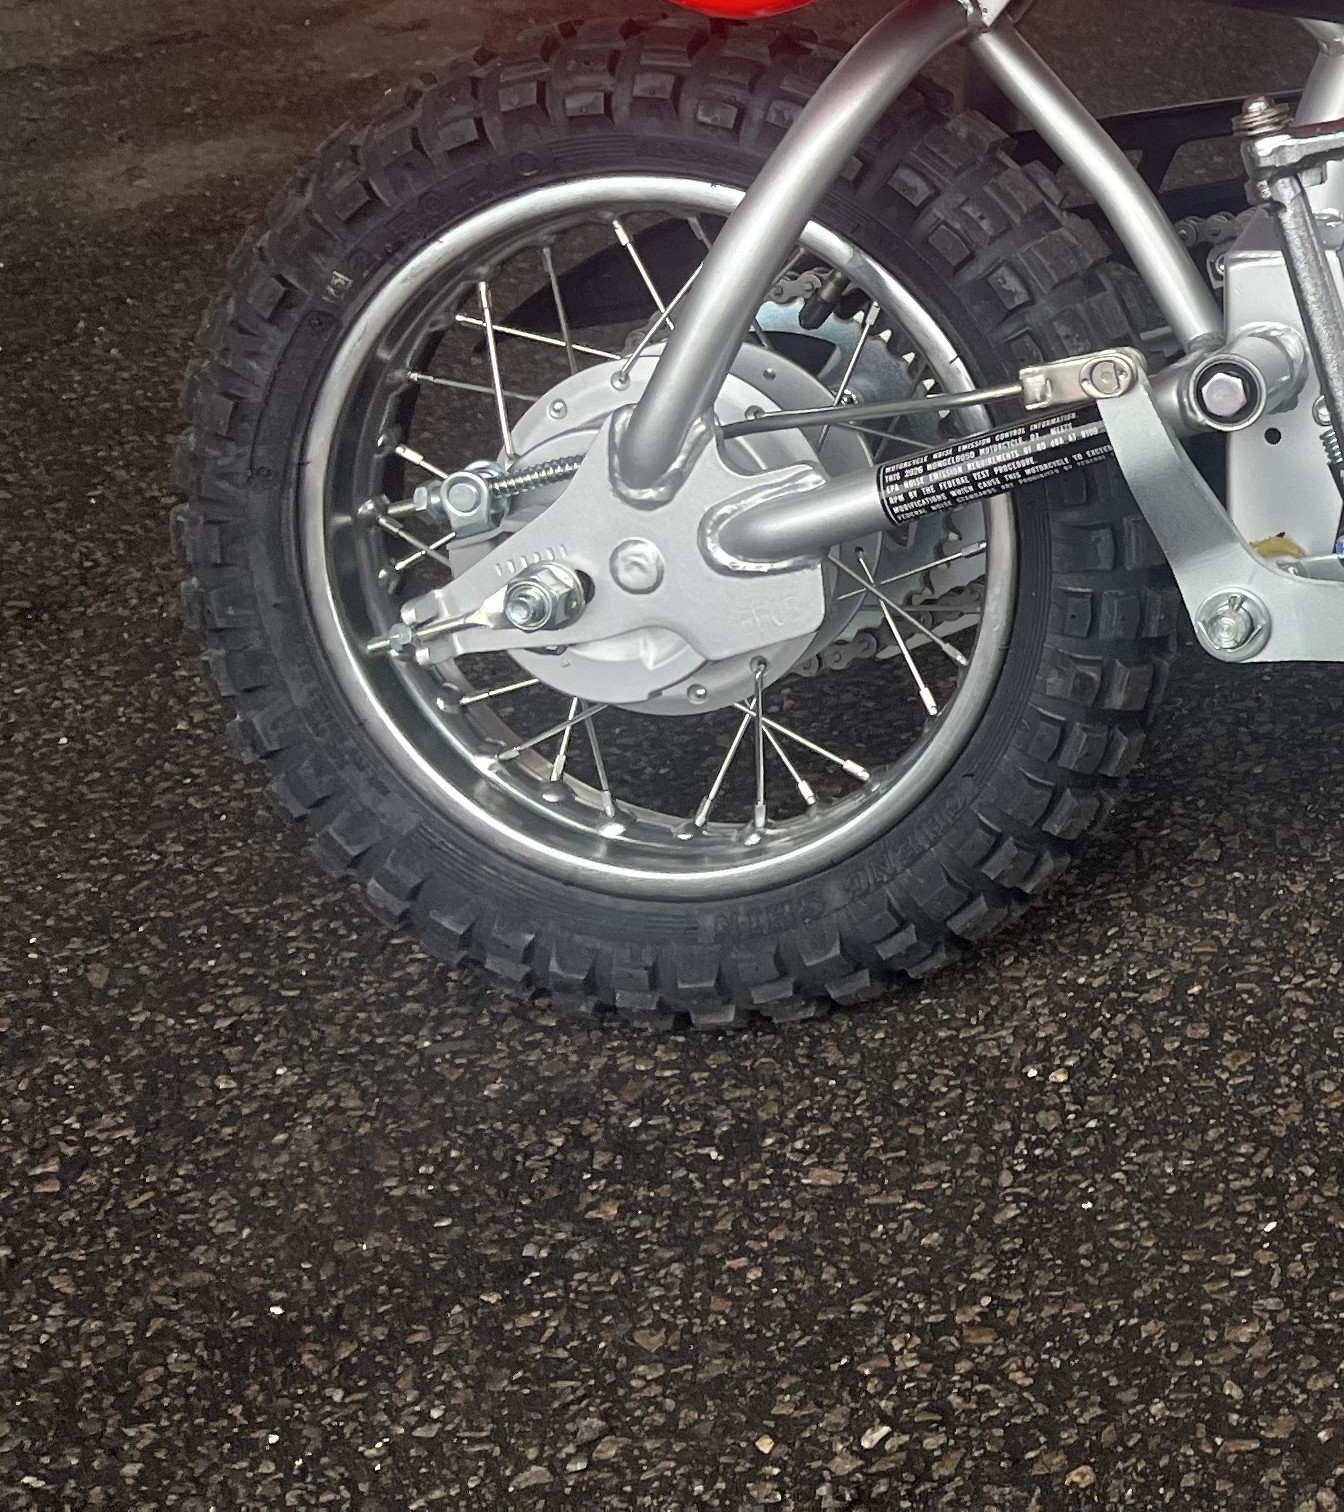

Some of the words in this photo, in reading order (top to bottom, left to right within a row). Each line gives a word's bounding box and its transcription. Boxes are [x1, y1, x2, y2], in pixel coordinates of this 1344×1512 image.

[921, 484, 936, 496] THE
[938, 475, 970, 491] FEDERAL
[971, 469, 990, 481] TEST
